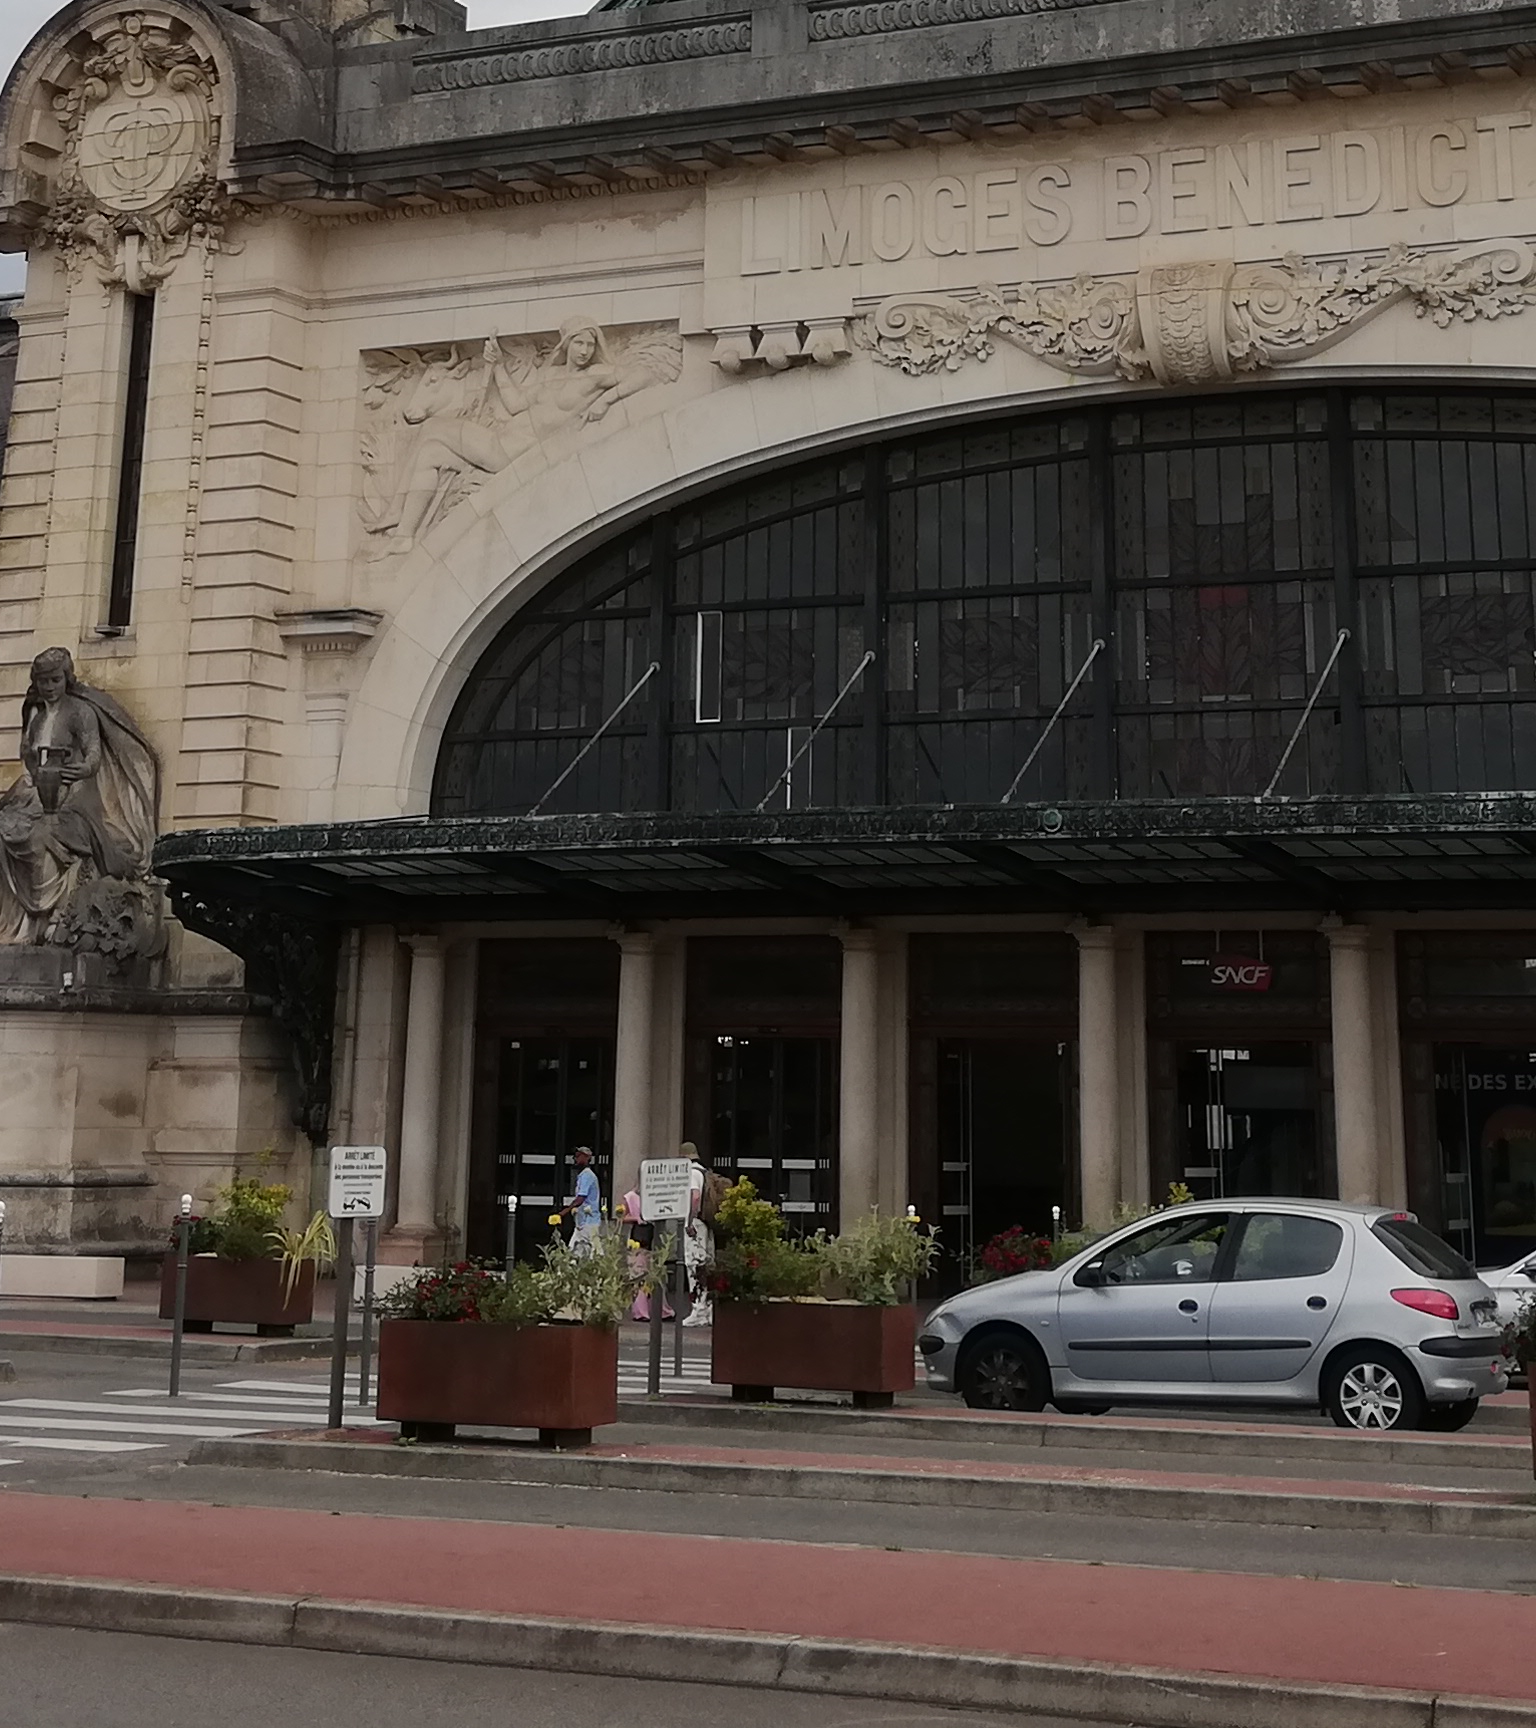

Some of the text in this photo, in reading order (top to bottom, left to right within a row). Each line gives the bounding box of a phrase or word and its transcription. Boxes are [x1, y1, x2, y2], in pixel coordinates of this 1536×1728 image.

[740, 163, 1073, 276] LIMOGES
[1211, 966, 1270, 984] SNCF
[1468, 1074, 1507, 1090] DES
